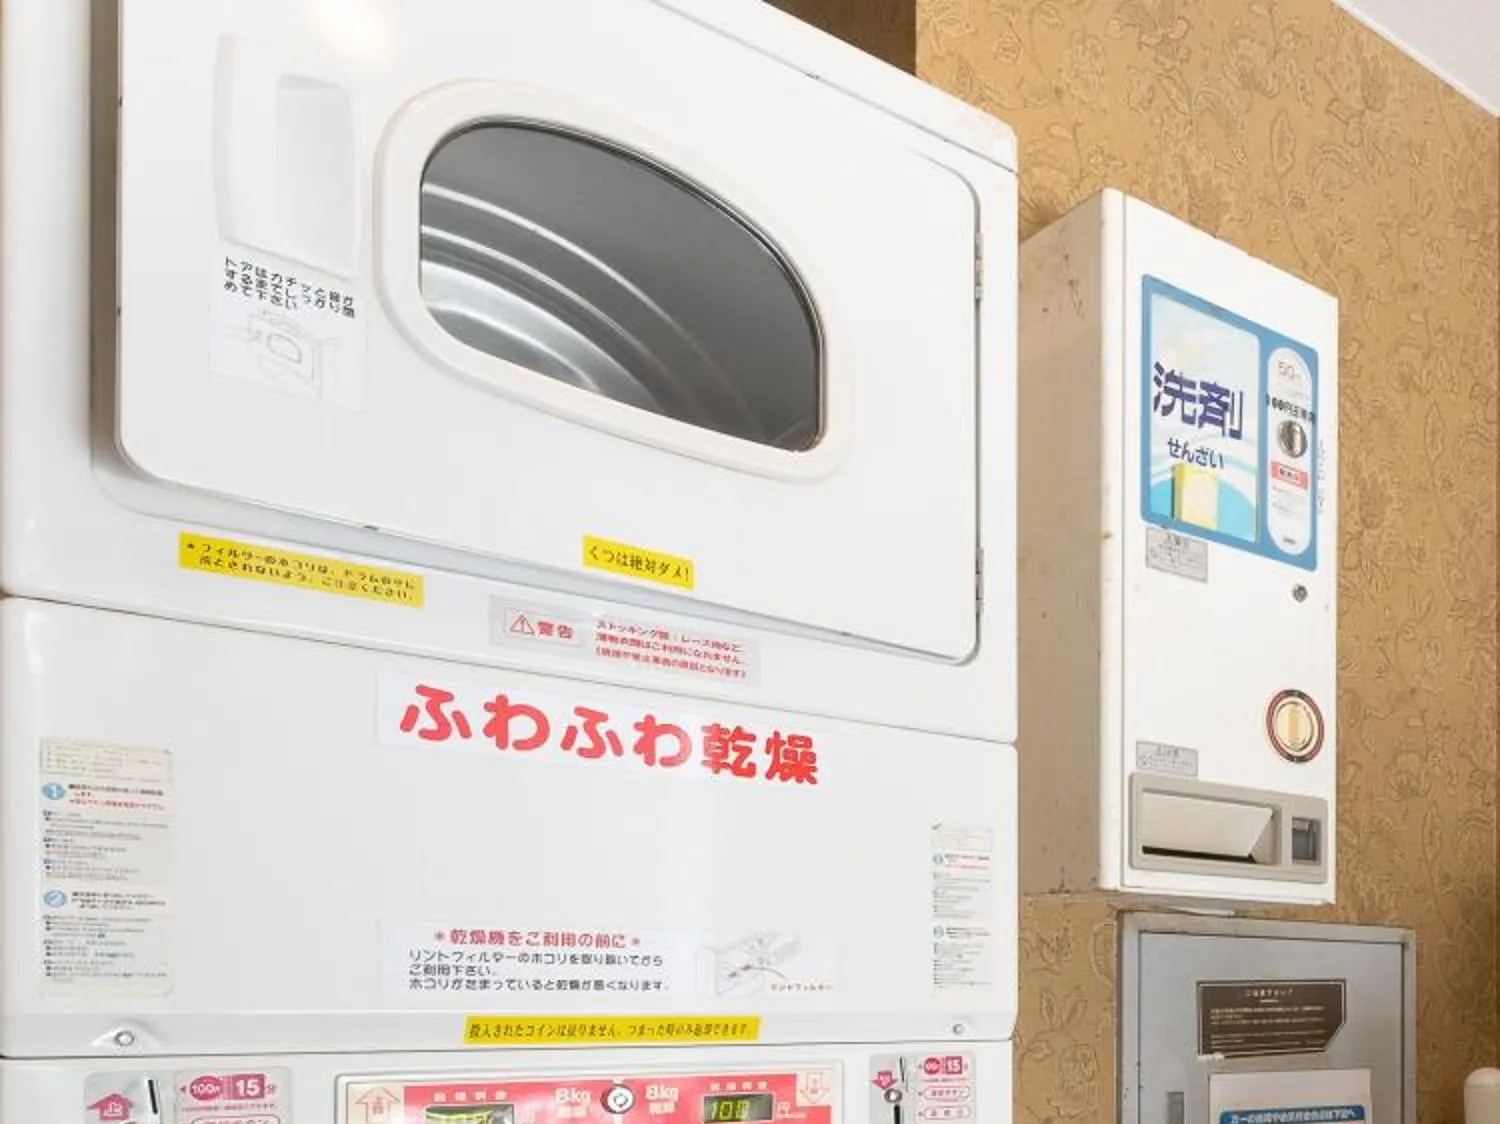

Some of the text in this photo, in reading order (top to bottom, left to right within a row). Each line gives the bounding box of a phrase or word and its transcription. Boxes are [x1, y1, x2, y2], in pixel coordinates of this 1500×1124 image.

[1153, 360, 1244, 441] 洗剤
[1167, 436, 1225, 470] せんざい
[536, 619, 575, 640] 警告
[400, 684, 819, 786] ふわふわ乾燥
